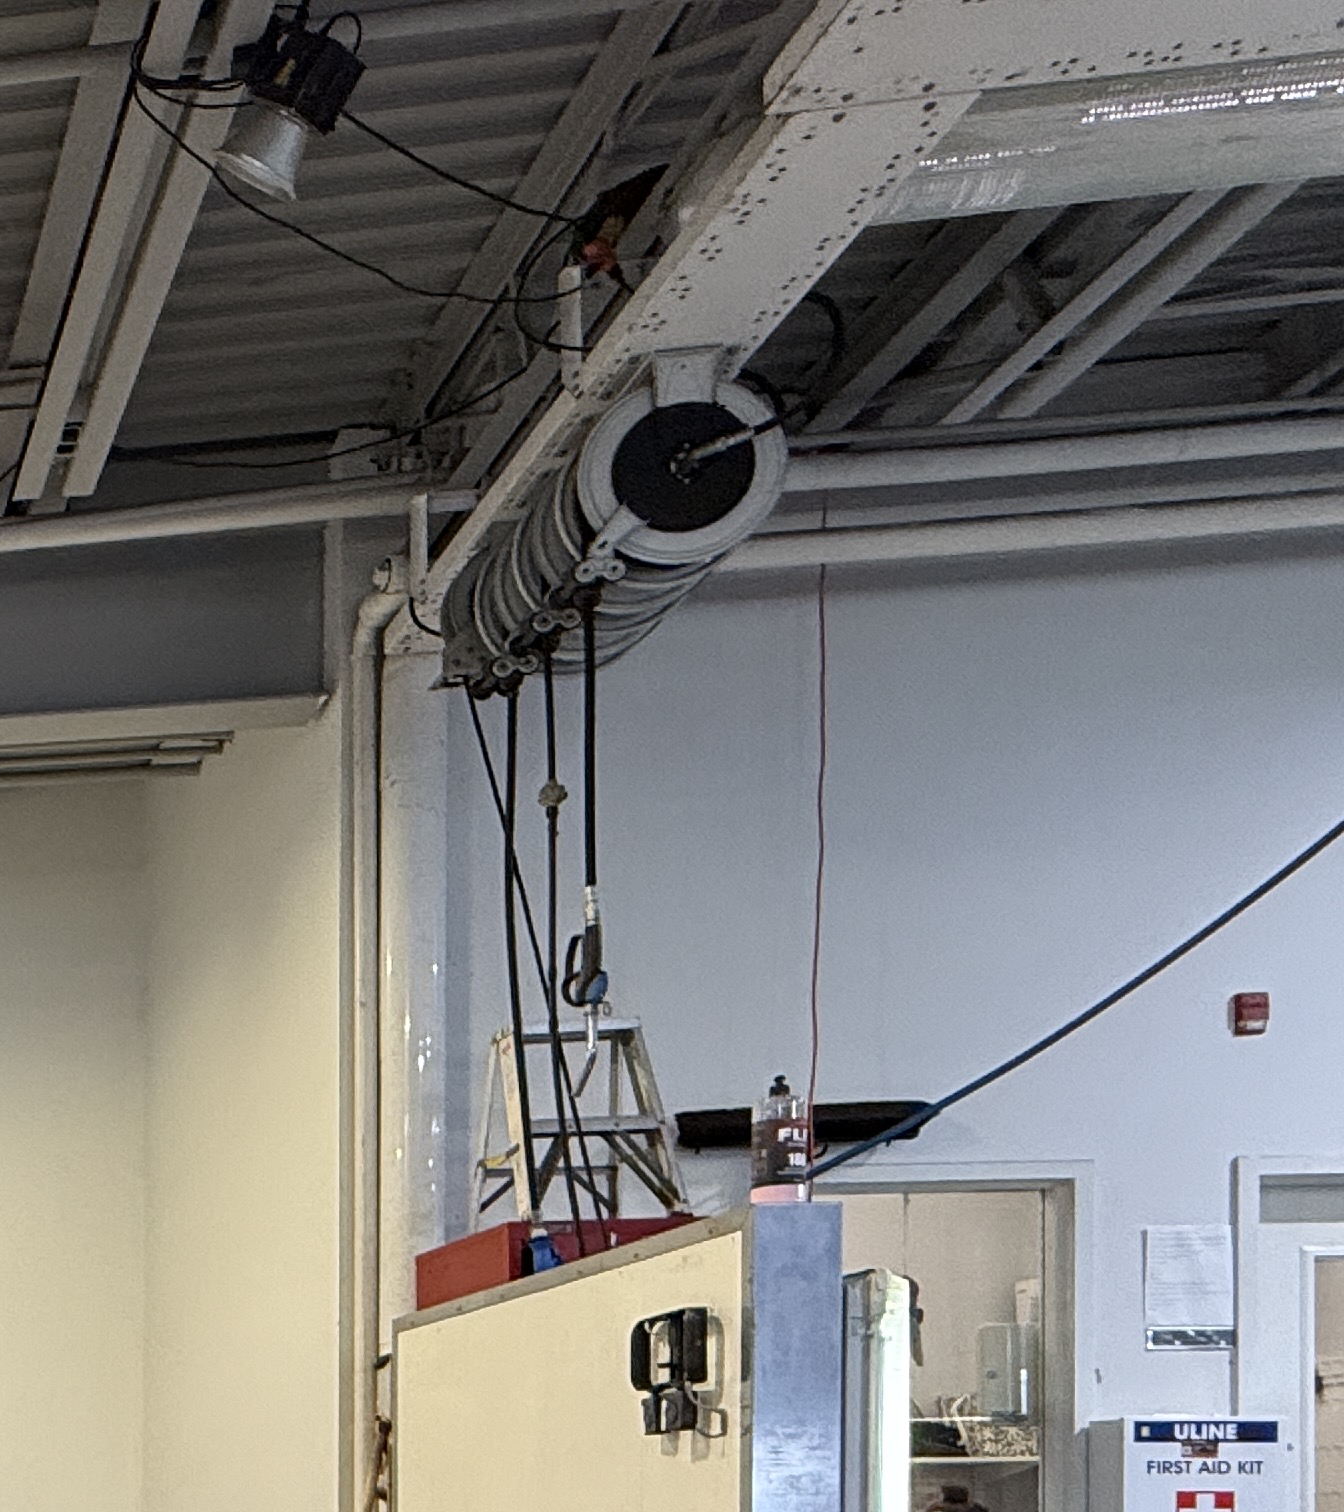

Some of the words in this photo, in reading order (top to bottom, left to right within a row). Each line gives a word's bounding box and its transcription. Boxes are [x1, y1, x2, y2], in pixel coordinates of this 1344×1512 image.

[1174, 1423, 1238, 1440] ULINE
[1146, 1460, 1193, 1474] FIRST
[1198, 1460, 1232, 1474] AID
[1238, 1460, 1264, 1474] KIT
